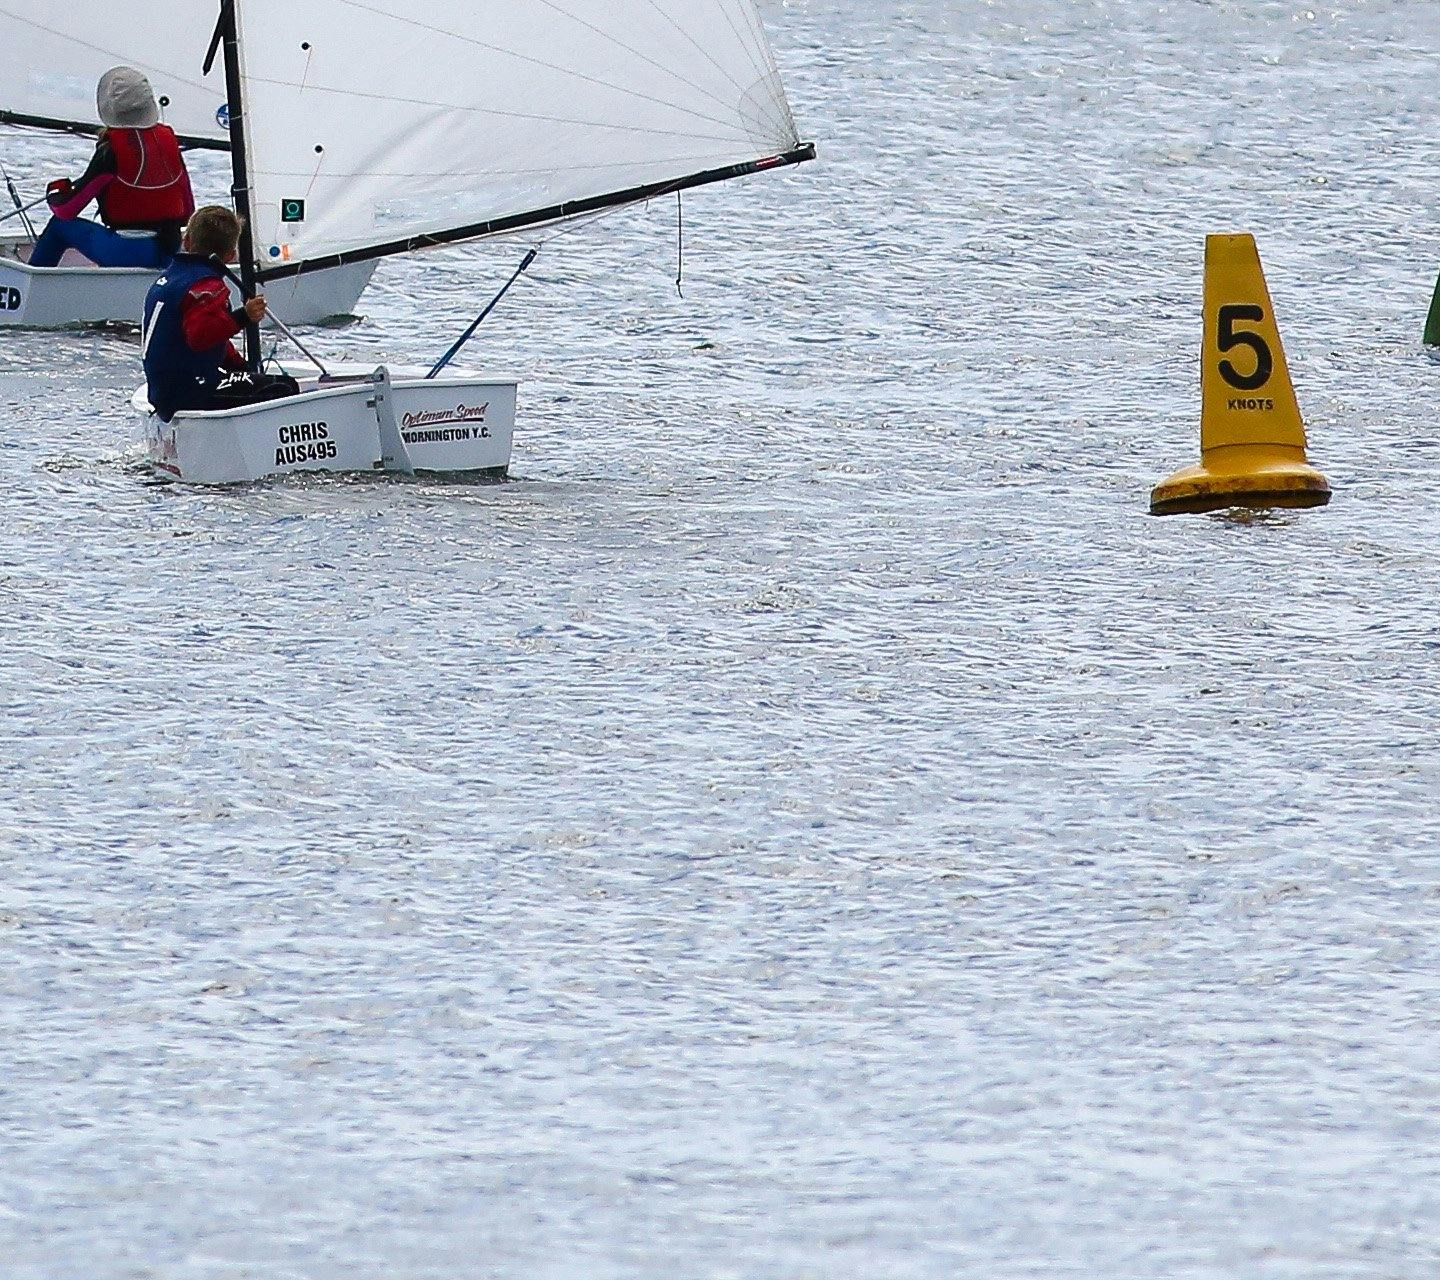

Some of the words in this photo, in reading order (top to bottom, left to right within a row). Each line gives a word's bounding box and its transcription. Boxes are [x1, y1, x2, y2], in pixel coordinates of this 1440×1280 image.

[1218, 304, 1273, 390] 5
[216, 366, 254, 390] Zhik
[456, 402, 490, 419] Speed
[1227, 398, 1274, 411] KNOTS
[278, 422, 329, 445] CHRIS
[401, 428, 470, 444] MORNINGTON
[472, 427, 492, 438] Y.C.
[275, 440, 338, 467] AUS495
